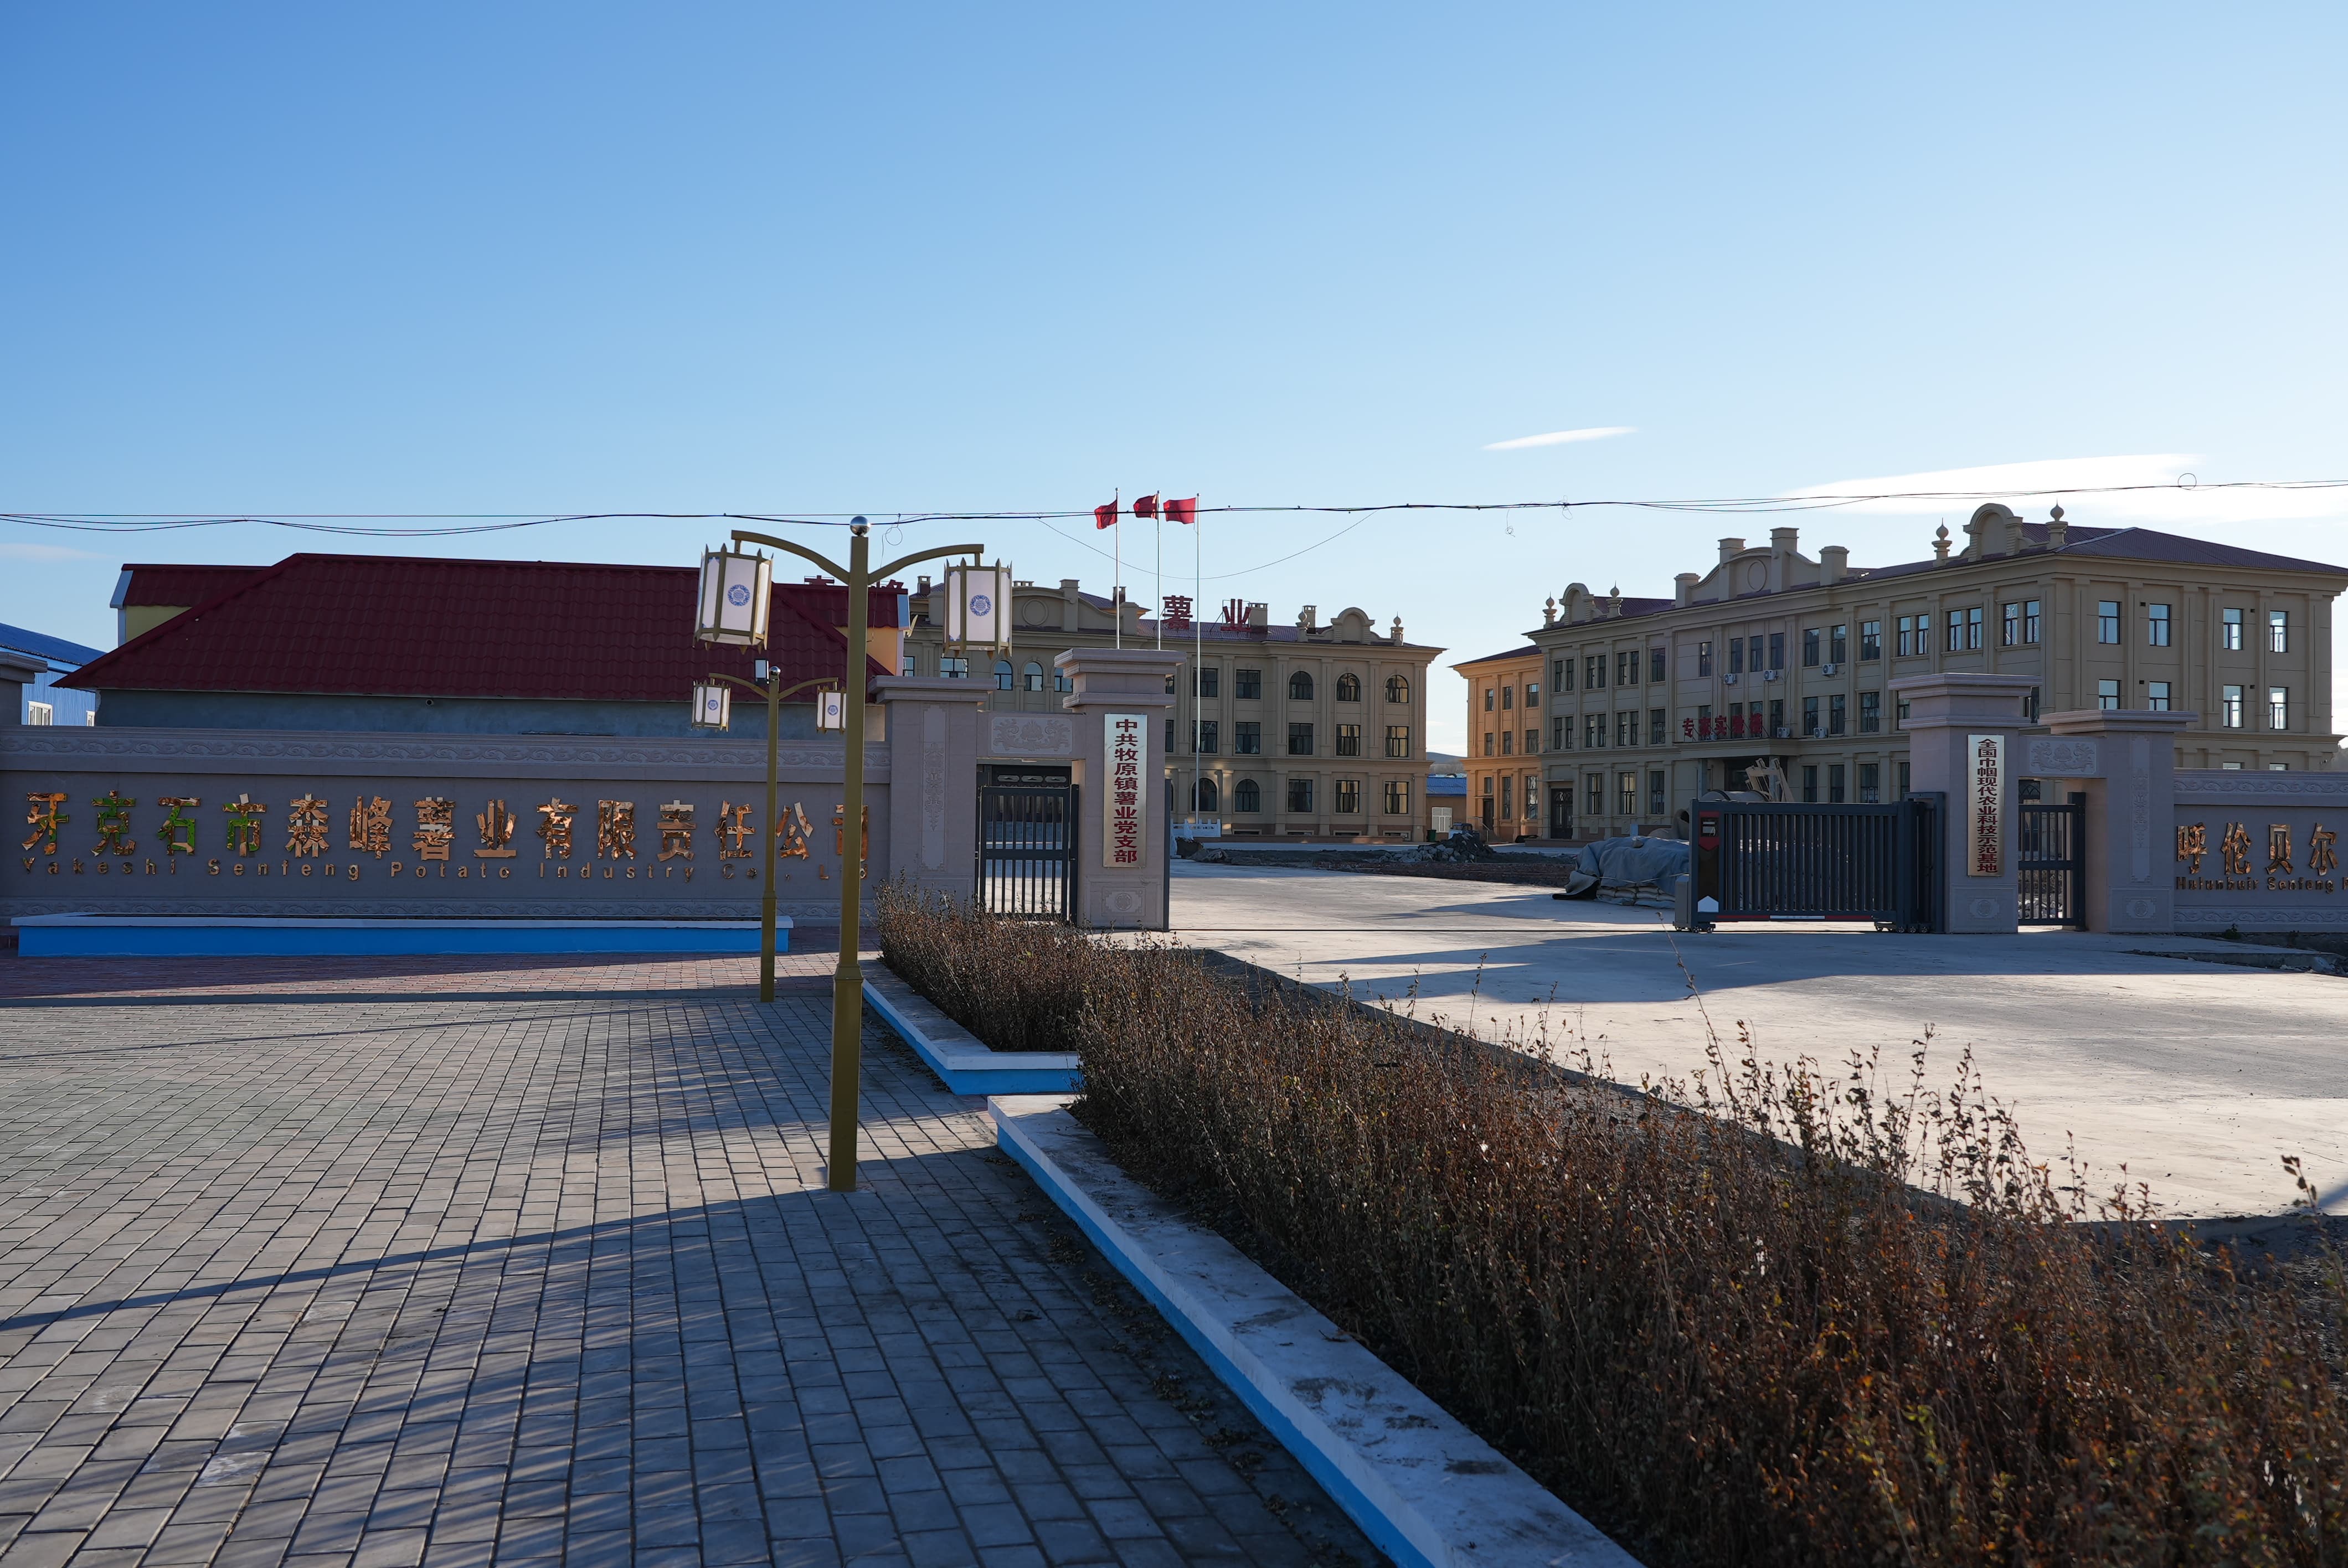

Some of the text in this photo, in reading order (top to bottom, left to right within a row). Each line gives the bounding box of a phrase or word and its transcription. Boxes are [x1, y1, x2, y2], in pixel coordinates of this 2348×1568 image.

[1161, 595, 1252, 632] 薯业
[1113, 719, 1139, 864] 中共牧原镇薯业党支部
[1977, 738, 1998, 873] 全国巾帼现代农业科技示范基地
[23, 857, 176, 875] Yakeshi
[208, 859, 359, 881] Senfeng
[390, 861, 510, 879] Potato
[540, 862, 694, 883] Industry
[819, 864, 868, 880] Ld
[2176, 822, 2339, 876] 呼伦贝尔
[2267, 876, 2334, 894] Senfeng
